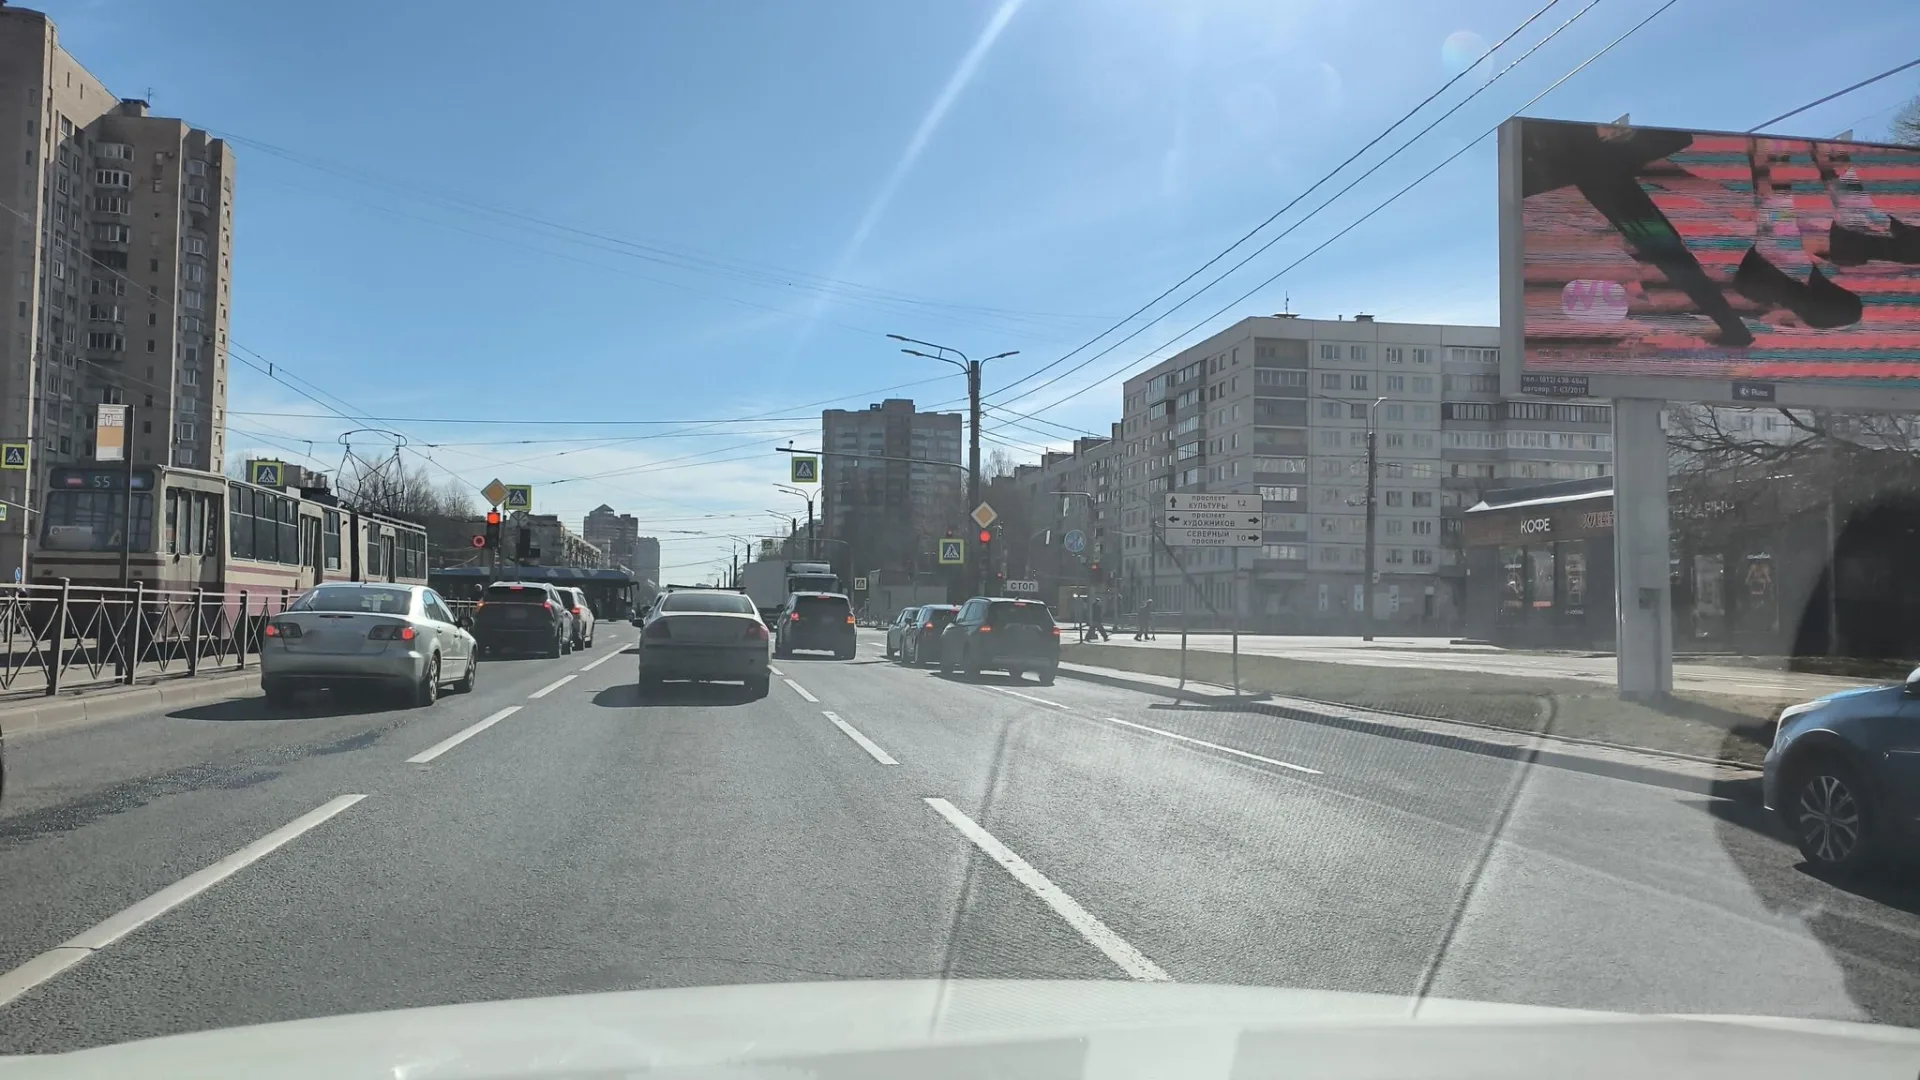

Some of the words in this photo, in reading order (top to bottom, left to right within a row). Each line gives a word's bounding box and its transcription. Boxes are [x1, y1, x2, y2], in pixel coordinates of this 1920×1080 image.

[94, 475, 111, 488] 55
[1188, 502, 1229, 510] КУЛЬТУРЫ
[1183, 519, 1236, 527] ХУДОЖНИКОВ
[1520, 517, 1551, 534] КОФЕ
[1186, 530, 1230, 538] СЕВЕРНЫЙ
[1010, 582, 1035, 591] СТОП
